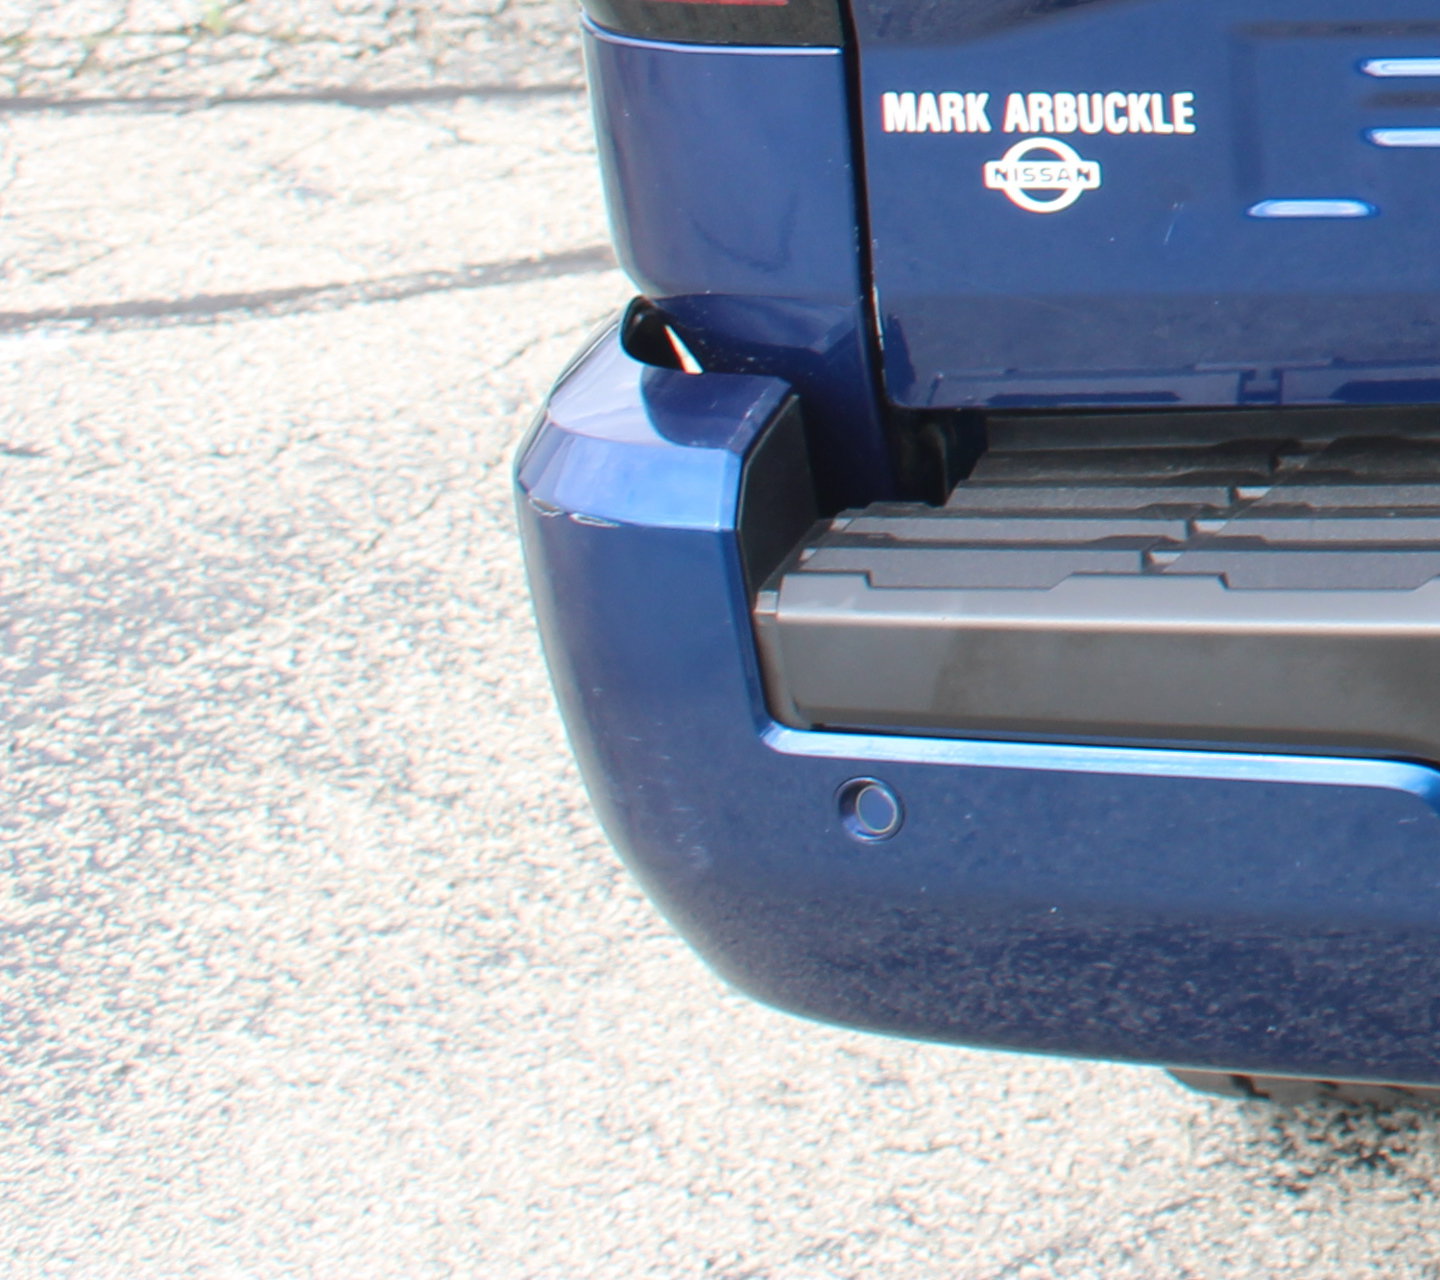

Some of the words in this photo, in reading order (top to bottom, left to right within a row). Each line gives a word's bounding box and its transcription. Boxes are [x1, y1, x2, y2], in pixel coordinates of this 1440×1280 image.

[882, 91, 992, 133] MARK
[1002, 92, 1196, 134] ARBUCKLE
[993, 165, 1091, 184] NISSAN
